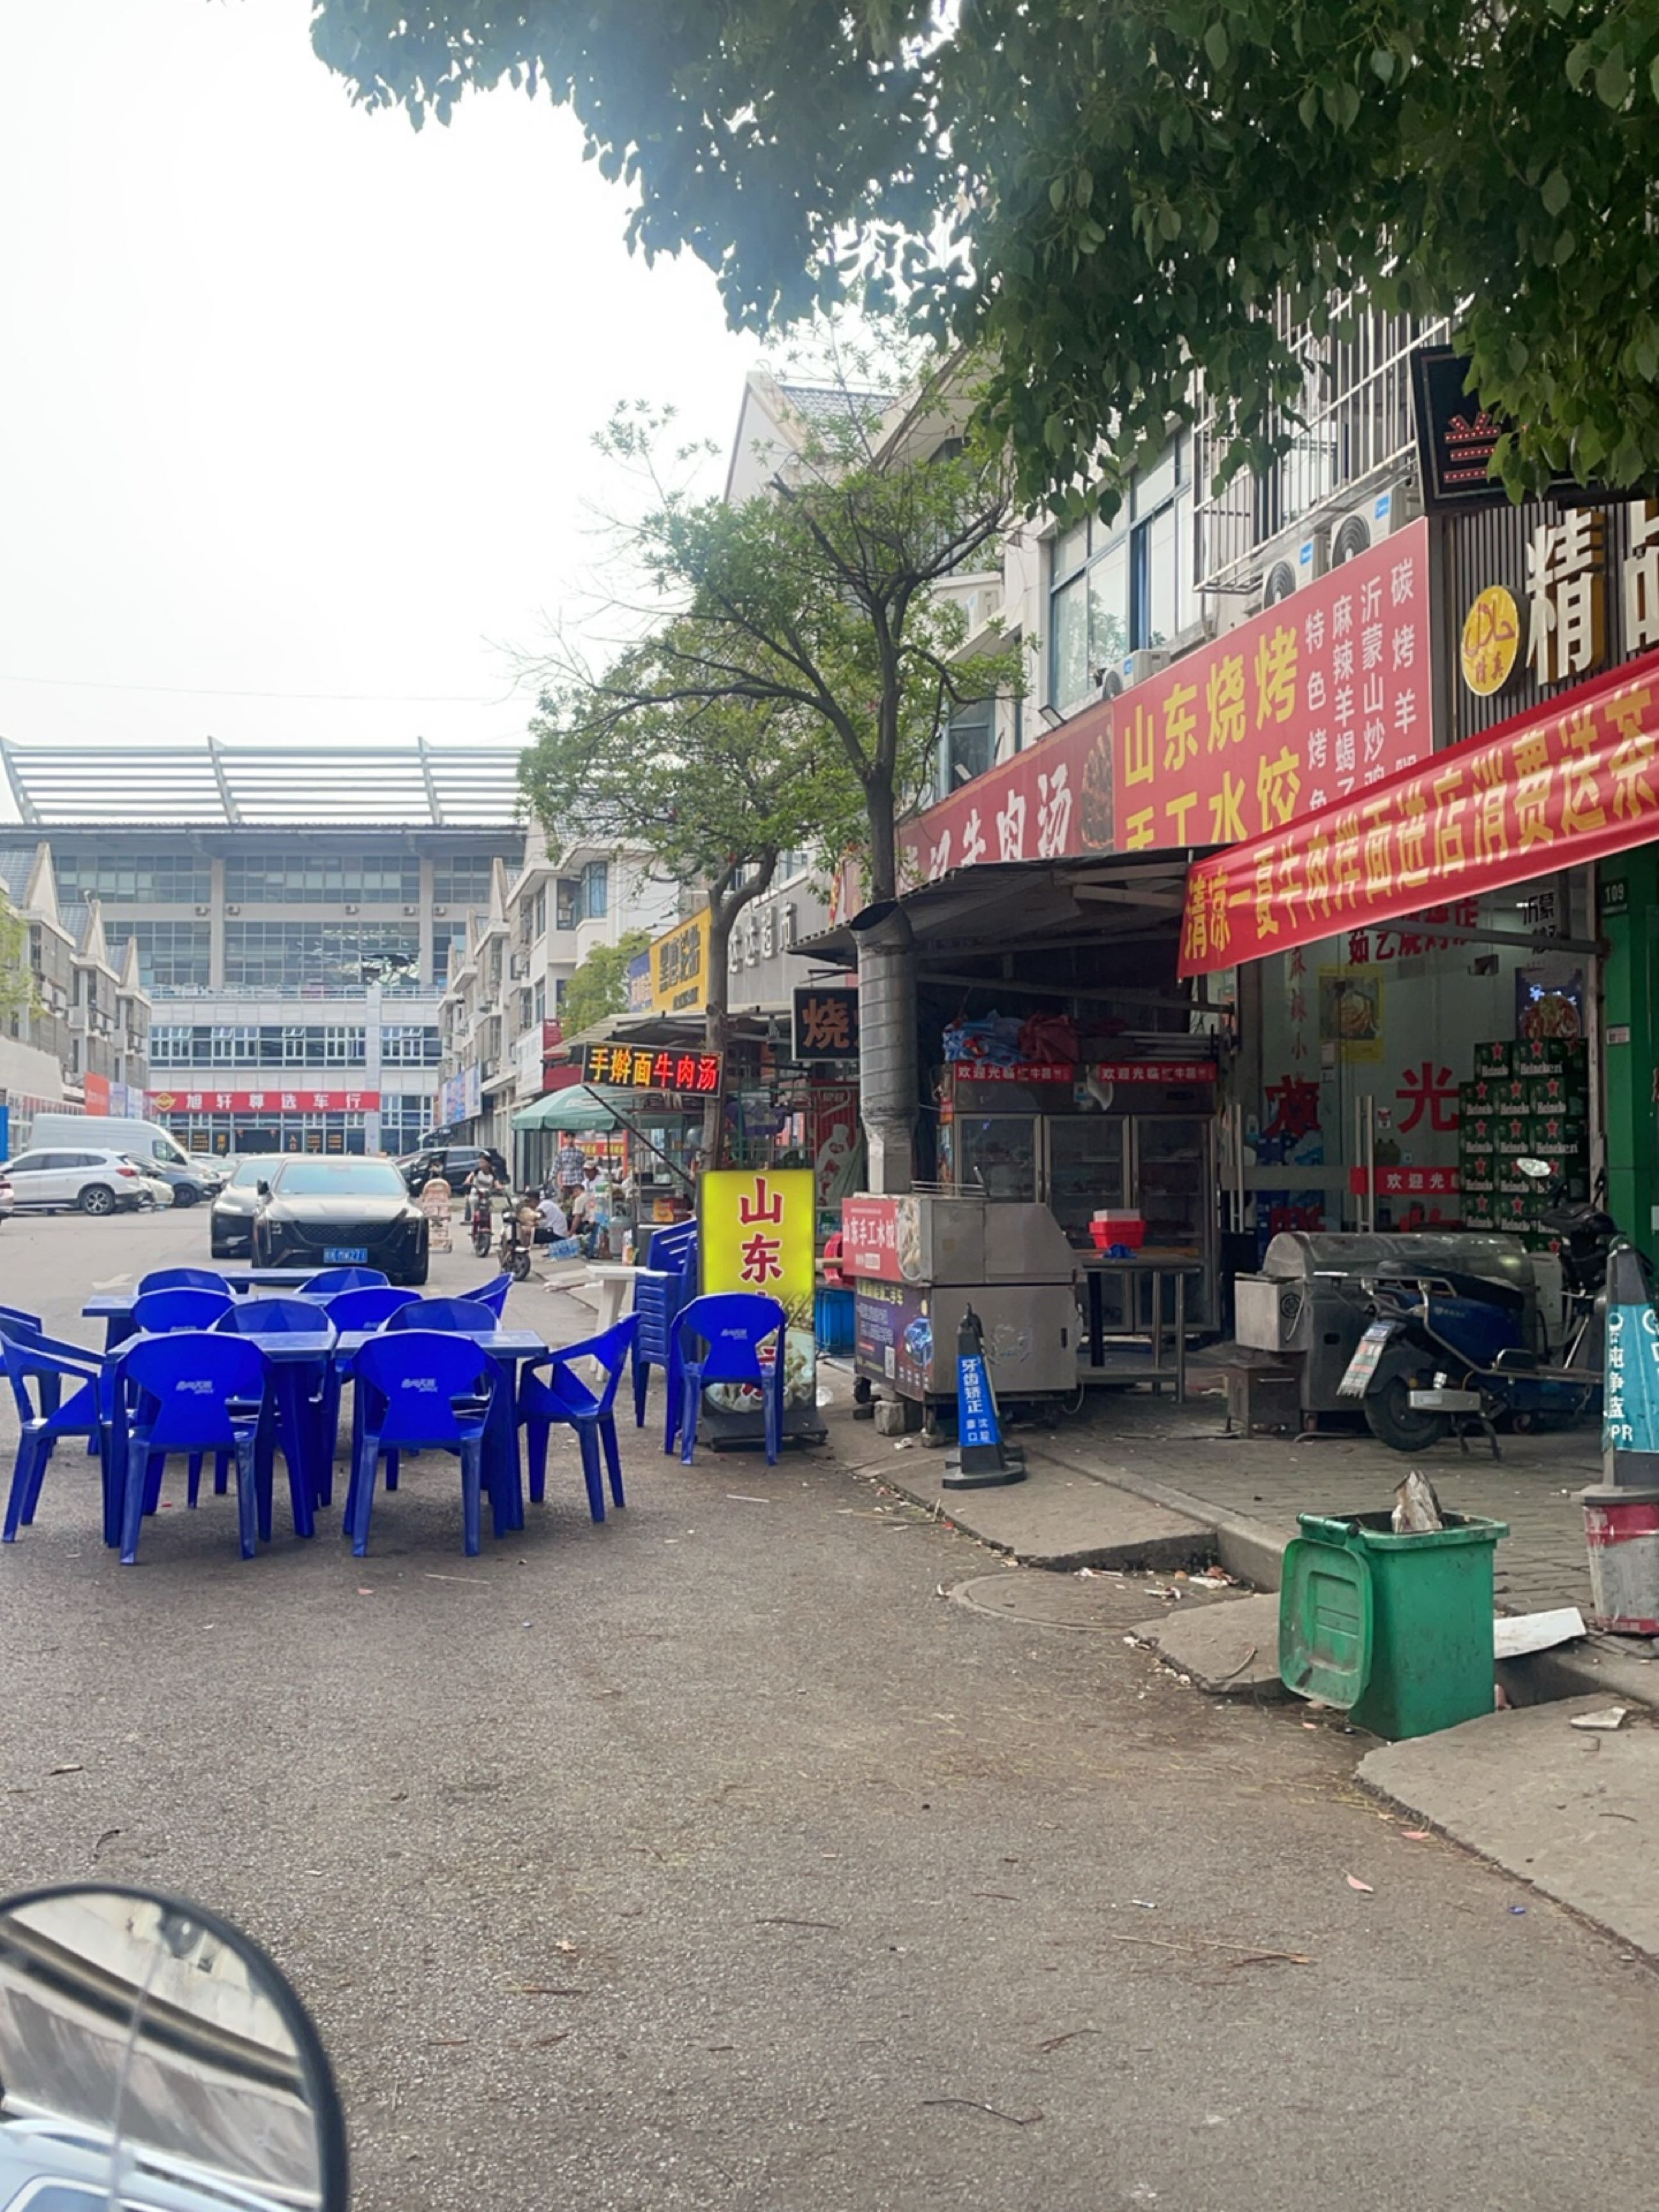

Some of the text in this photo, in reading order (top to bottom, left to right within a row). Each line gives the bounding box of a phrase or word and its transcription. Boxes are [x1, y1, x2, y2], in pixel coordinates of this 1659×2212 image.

[1125, 625, 1299, 787] 山东烧烤
[1605, 883, 1624, 902] 109
[801, 998, 858, 1050] 烧
[589, 1047, 717, 1091] 手擀面牛肉汤
[186, 1093, 362, 1110] 旭轩尊选车行
[1396, 1063, 1460, 1133] 光
[962, 1359, 983, 1414] 牙齿矫正
